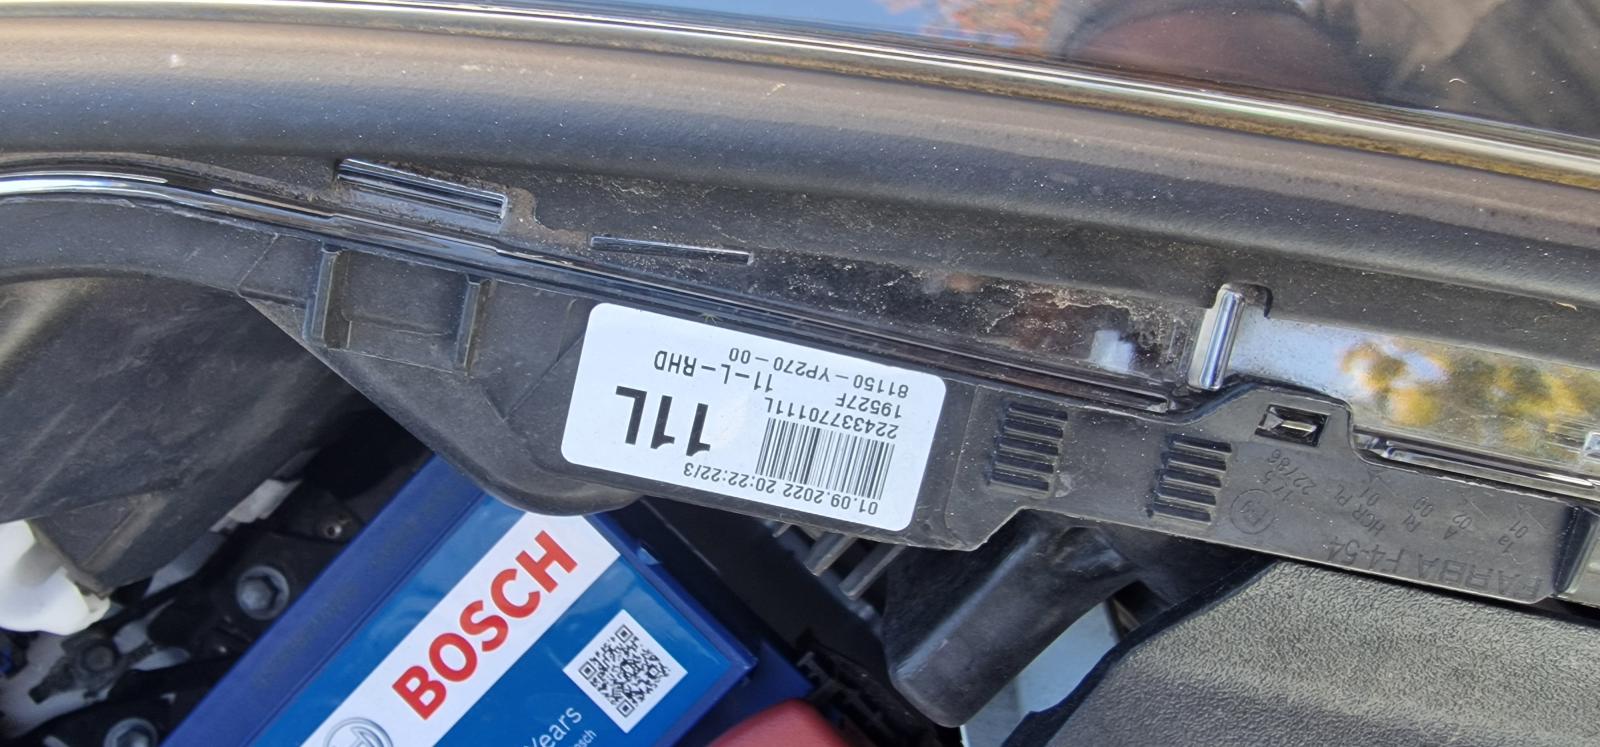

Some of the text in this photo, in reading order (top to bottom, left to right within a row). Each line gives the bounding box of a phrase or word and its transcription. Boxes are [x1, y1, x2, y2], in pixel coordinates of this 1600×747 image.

[614, 384, 712, 457] 11L
[764, 397, 899, 439] 22433770111L
[835, 392, 903, 420] 19527F
[683, 462, 879, 517] 01.09.2022 20:22:22/3
[391, 530, 578, 720] BOSCH
